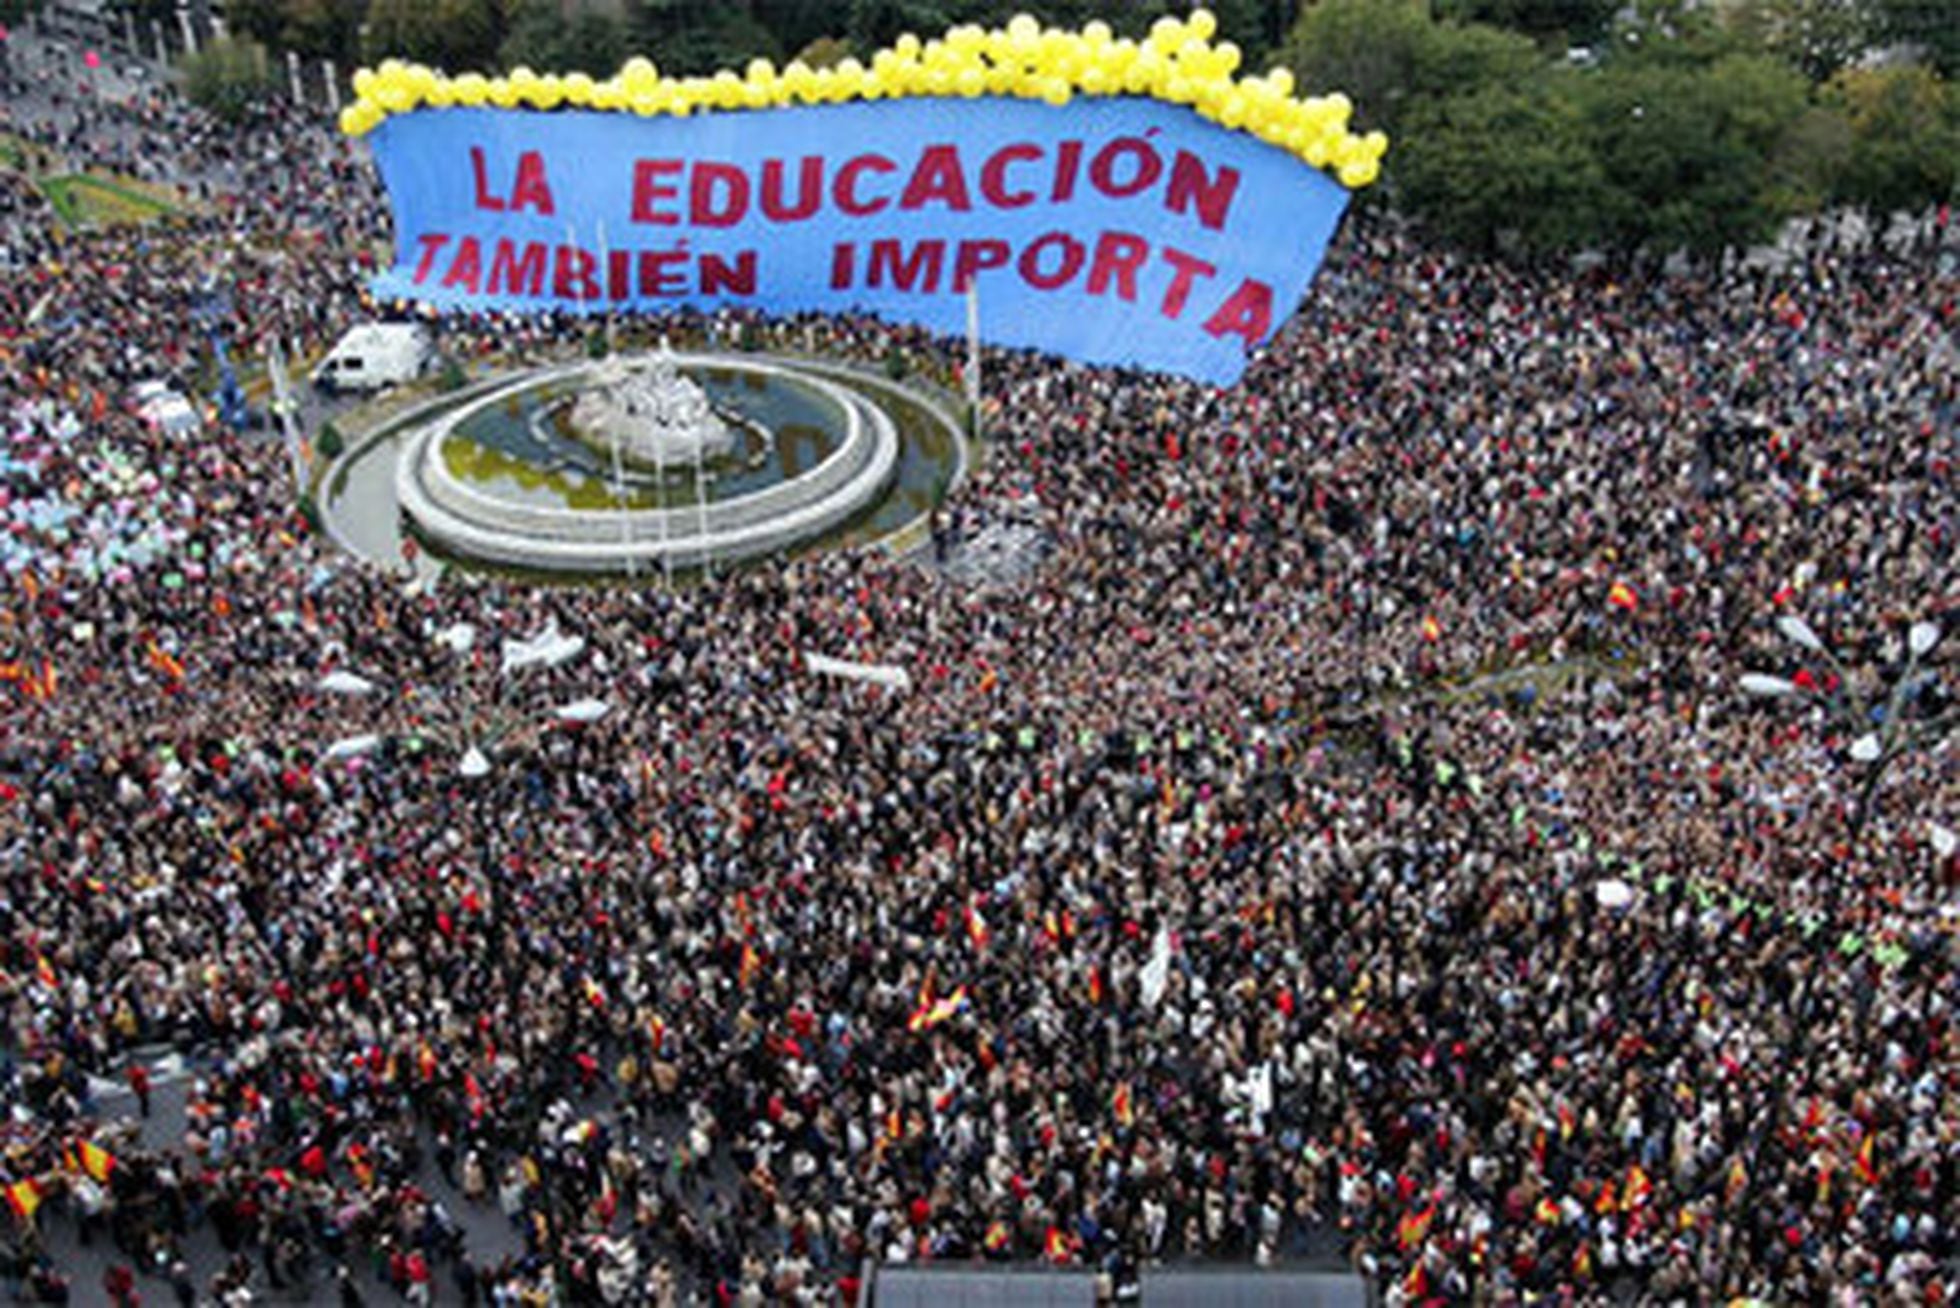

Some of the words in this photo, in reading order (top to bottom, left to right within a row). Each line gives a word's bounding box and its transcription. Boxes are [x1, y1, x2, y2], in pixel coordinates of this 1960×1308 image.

[470, 146, 554, 215] LA
[631, 127, 1241, 231] EDUCACIÓN
[412, 232, 758, 300] TAMBIÉN
[830, 230, 1275, 348] IMPORTA
